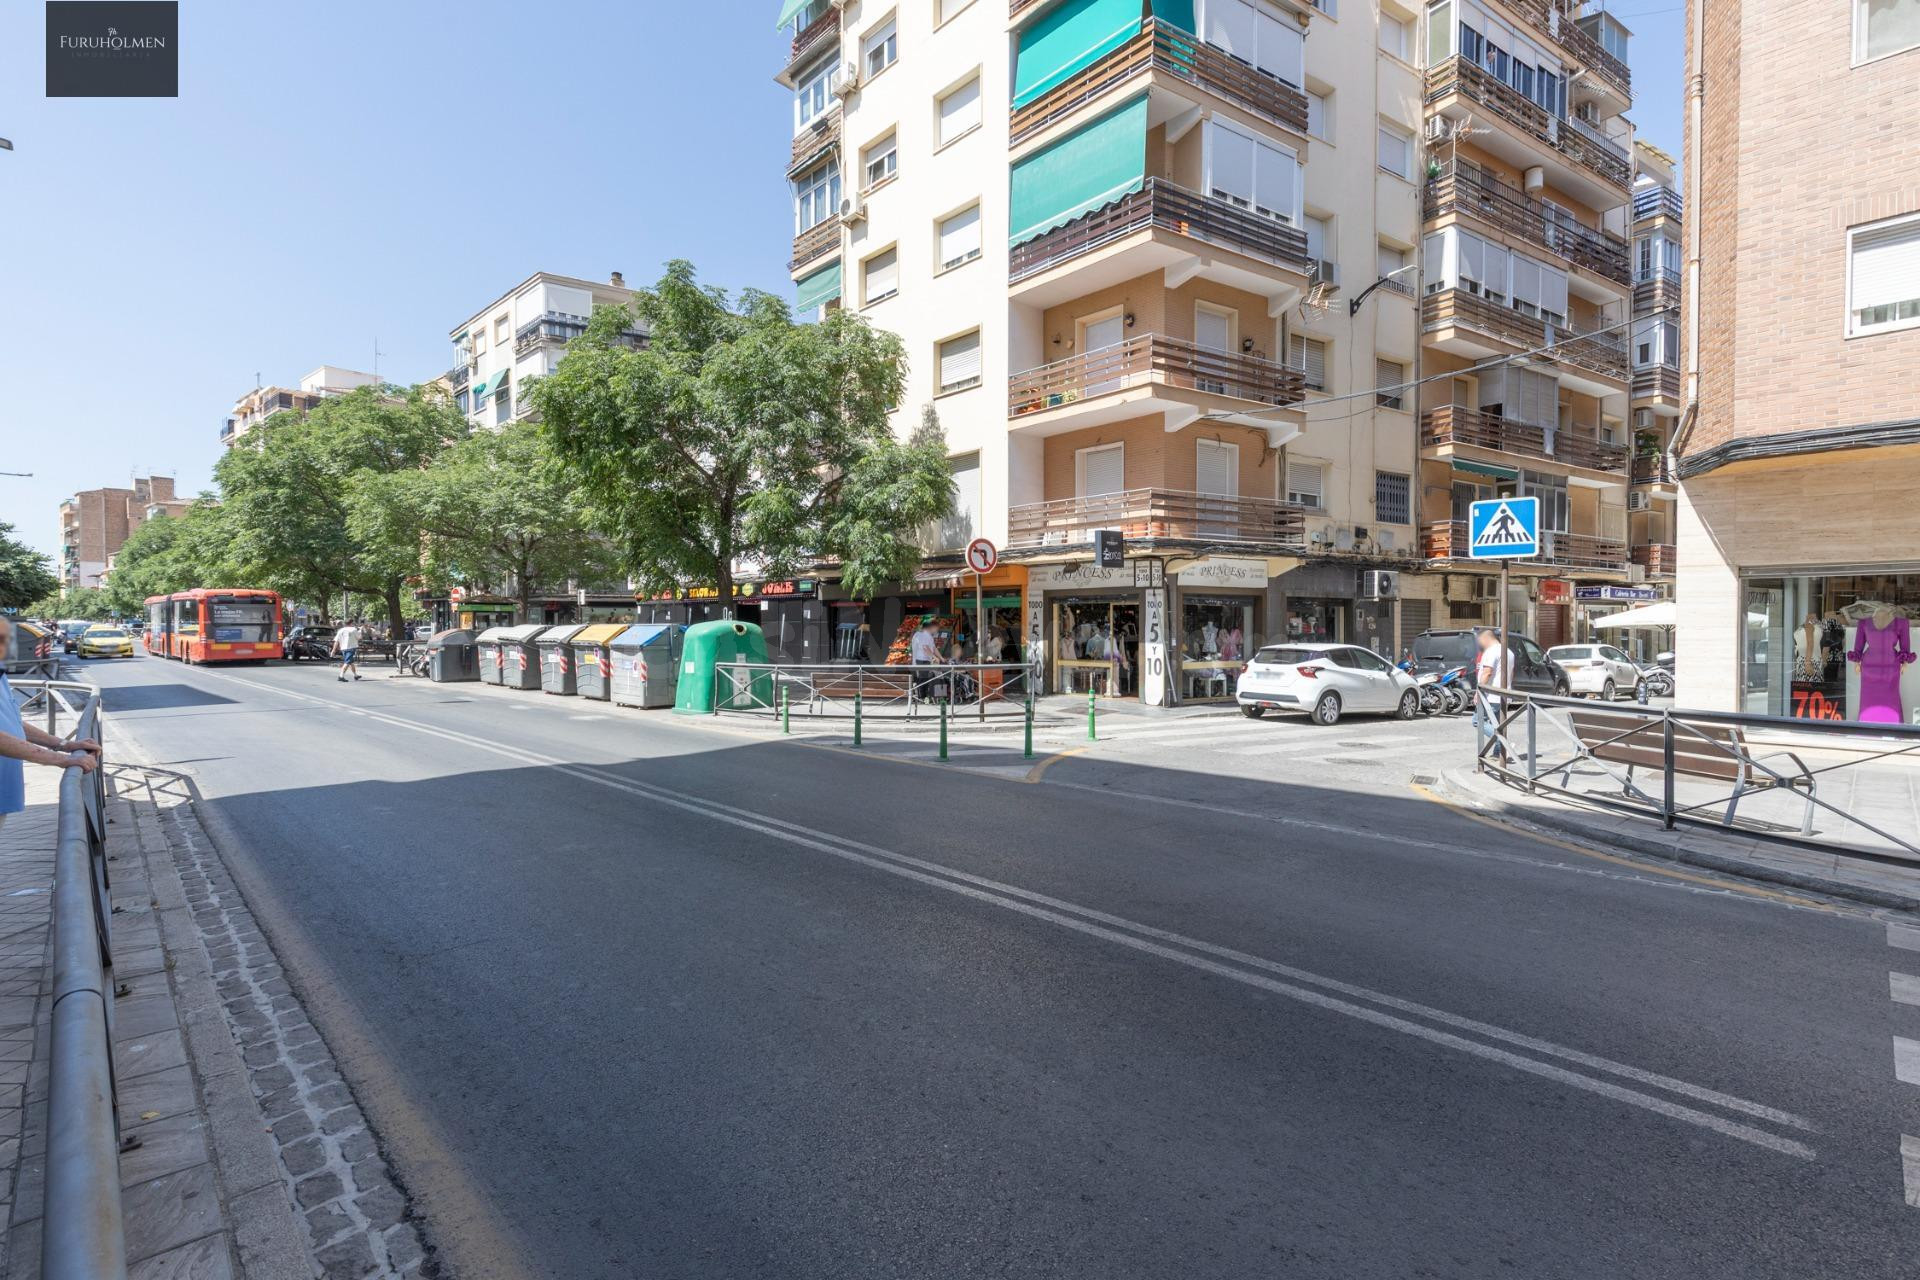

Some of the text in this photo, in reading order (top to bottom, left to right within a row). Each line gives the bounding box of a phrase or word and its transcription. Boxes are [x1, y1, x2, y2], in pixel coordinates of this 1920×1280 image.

[1201, 566, 1246, 578] PRINCESS
[1152, 611, 1157, 619] A
[1150, 623, 1159, 642] 5
[1152, 646, 1157, 655] Y
[1147, 658, 1162, 676] 10
